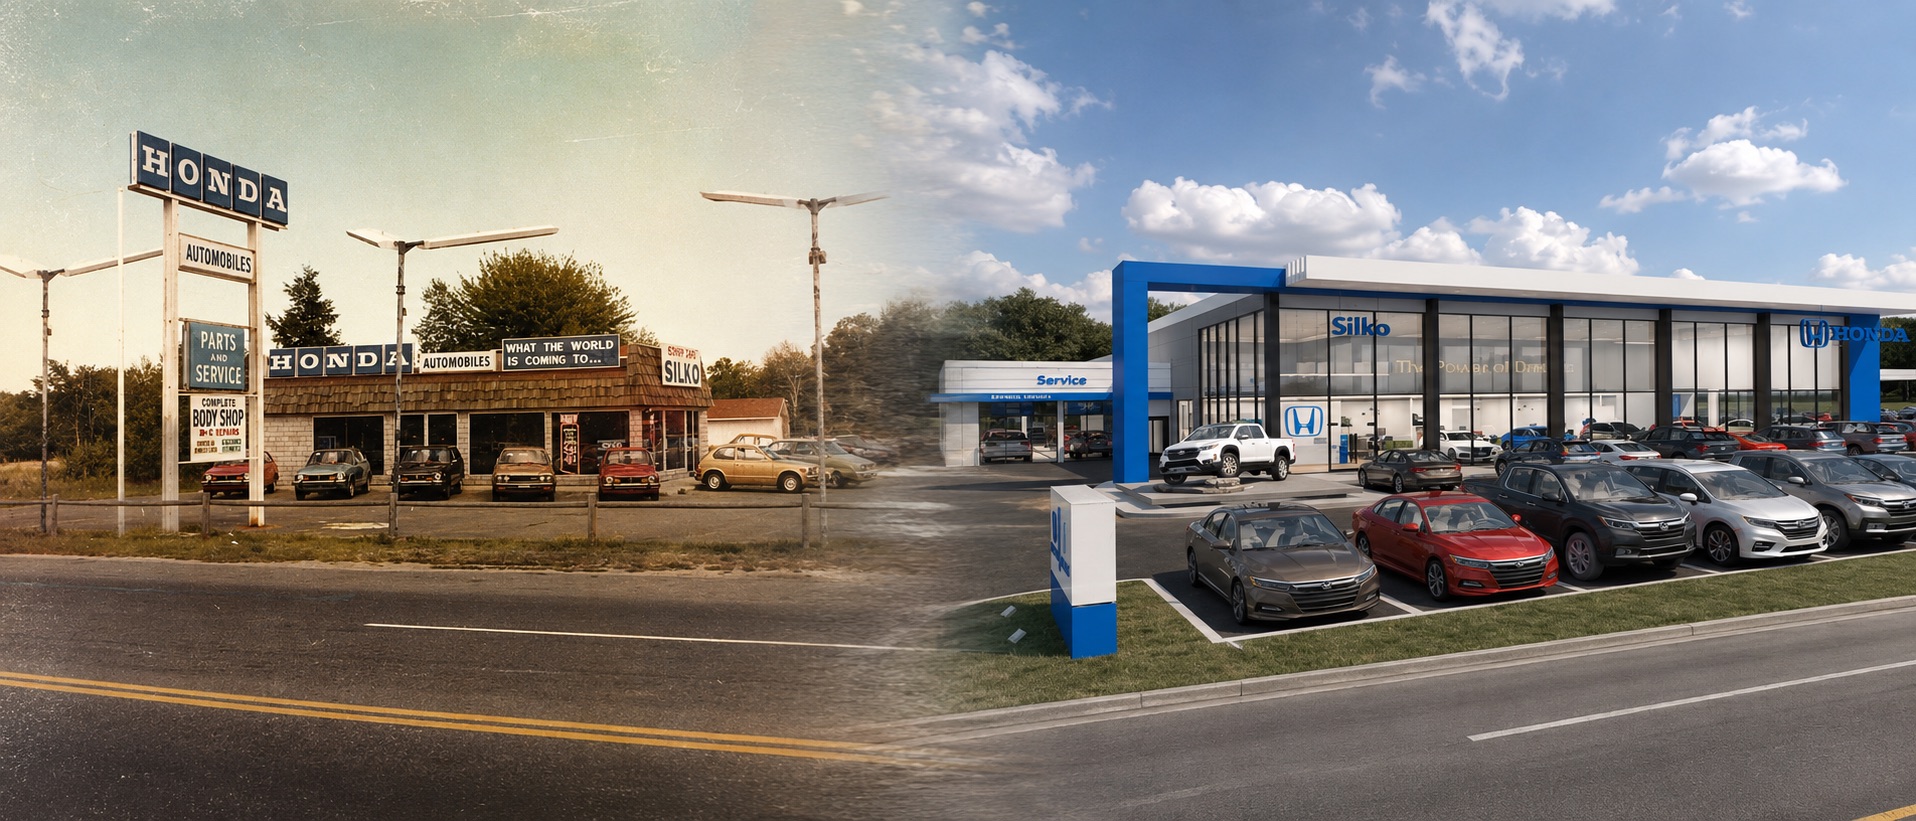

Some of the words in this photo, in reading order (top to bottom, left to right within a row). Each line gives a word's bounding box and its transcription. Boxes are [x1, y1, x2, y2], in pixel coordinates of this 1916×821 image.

[142, 144, 287, 213] HONDA
[186, 243, 251, 273] AUTOMOBILES
[1332, 316, 1391, 336] Silko
[1831, 326, 1911, 342] HONDA
[201, 331, 236, 351] PARTS
[506, 342, 537, 353] WHAT
[543, 342, 563, 352] THE
[571, 340, 614, 351] WORLD
[210, 353, 228, 362] AND
[270, 352, 409, 370] HONDA
[423, 355, 490, 369] AUTOMOBILES
[507, 356, 518, 366] IS
[525, 354, 566, 365] COMING
[573, 354, 601, 364] TO...
[195, 364, 242, 384] SERVICE
[664, 359, 700, 385] SILKO
[1036, 375, 1087, 386] Service
[201, 398, 236, 407] COMPLETE
[193, 409, 217, 427] BODY
[219, 409, 244, 427] SHOP
